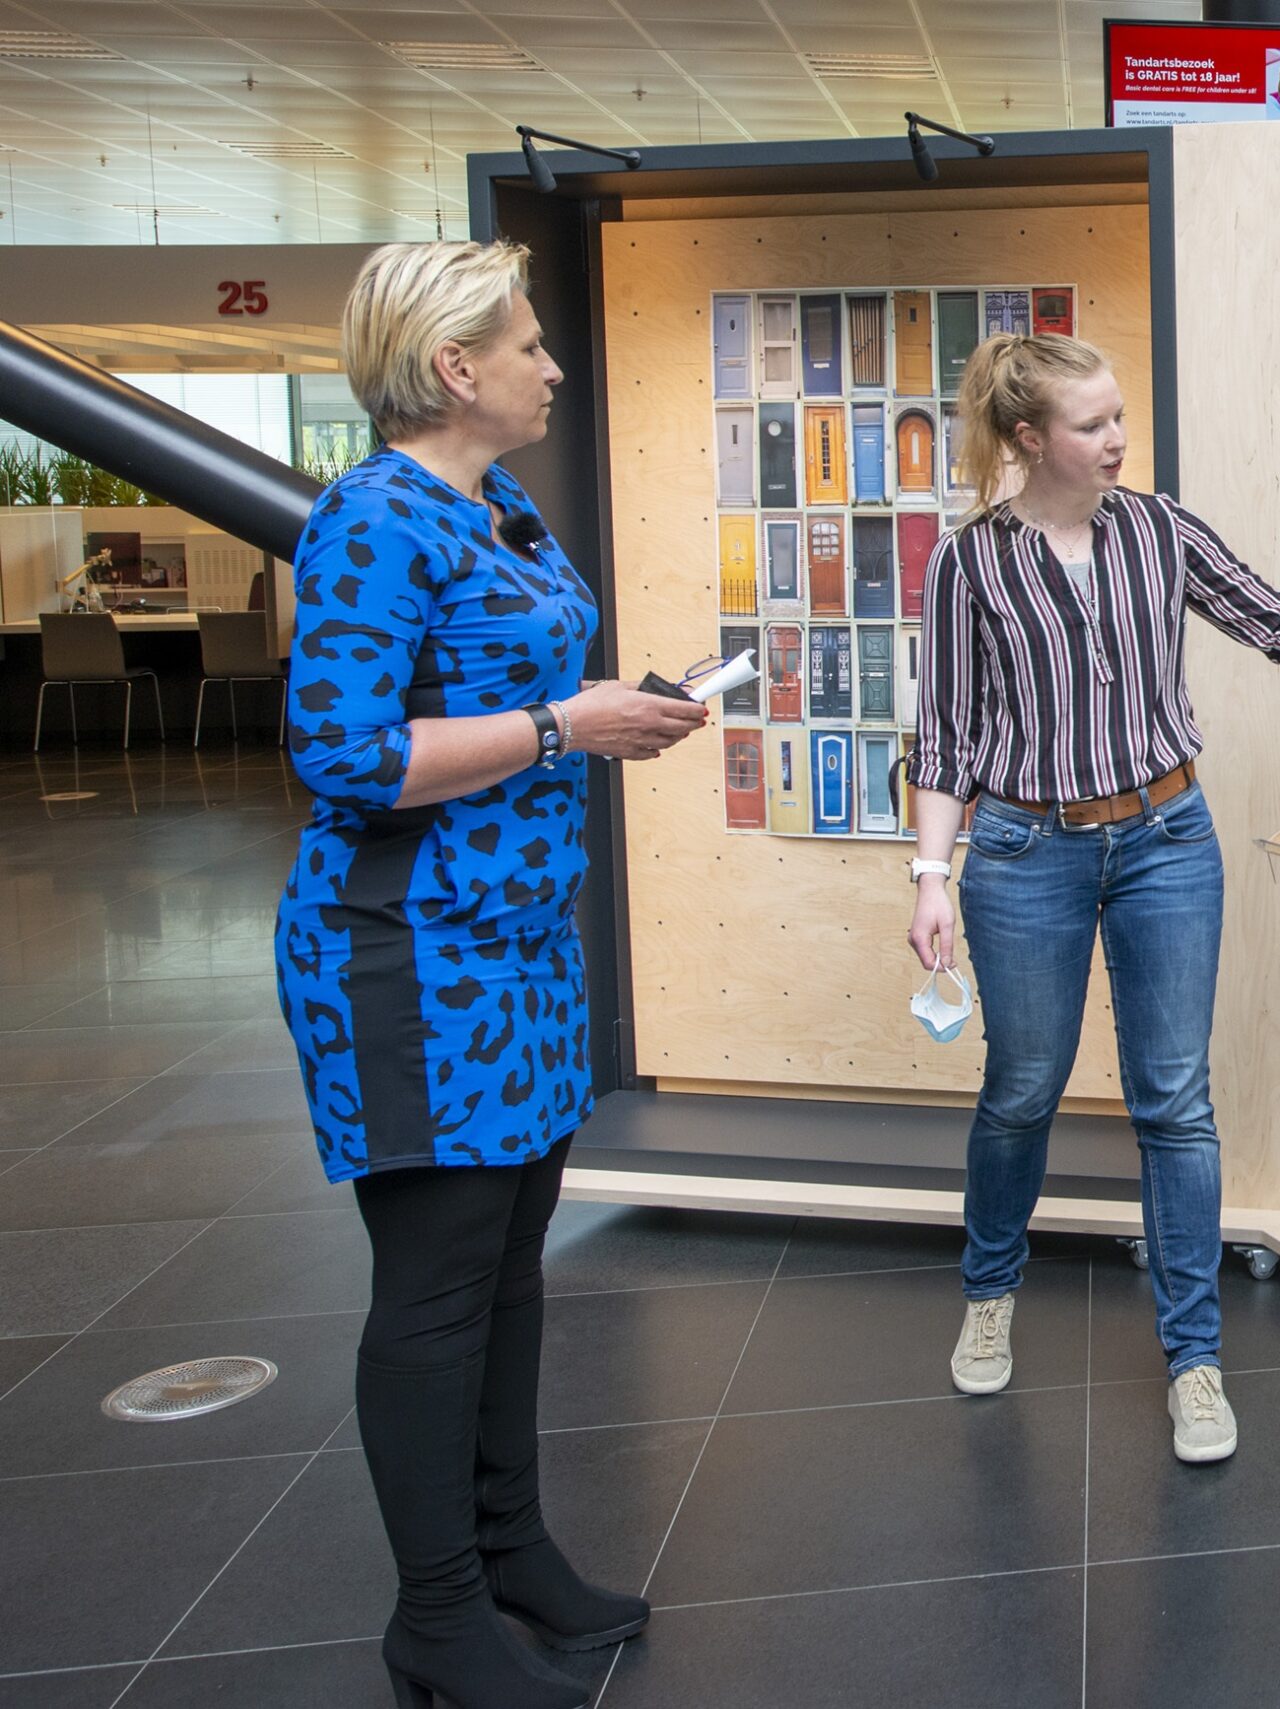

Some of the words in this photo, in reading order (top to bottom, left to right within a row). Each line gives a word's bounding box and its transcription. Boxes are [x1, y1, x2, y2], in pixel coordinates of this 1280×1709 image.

[1125, 56, 1215, 69] Tandartsbezoek
[1125, 70, 1134, 80] is
[1137, 70, 1178, 81] GRATIS
[1181, 71, 1197, 82] tot
[1200, 72, 1212, 82] 18
[1214, 72, 1241, 84] jaar!
[1125, 84, 1141, 92] Basic
[1196, 86, 1206, 94] for
[217, 281, 268, 314] 25
